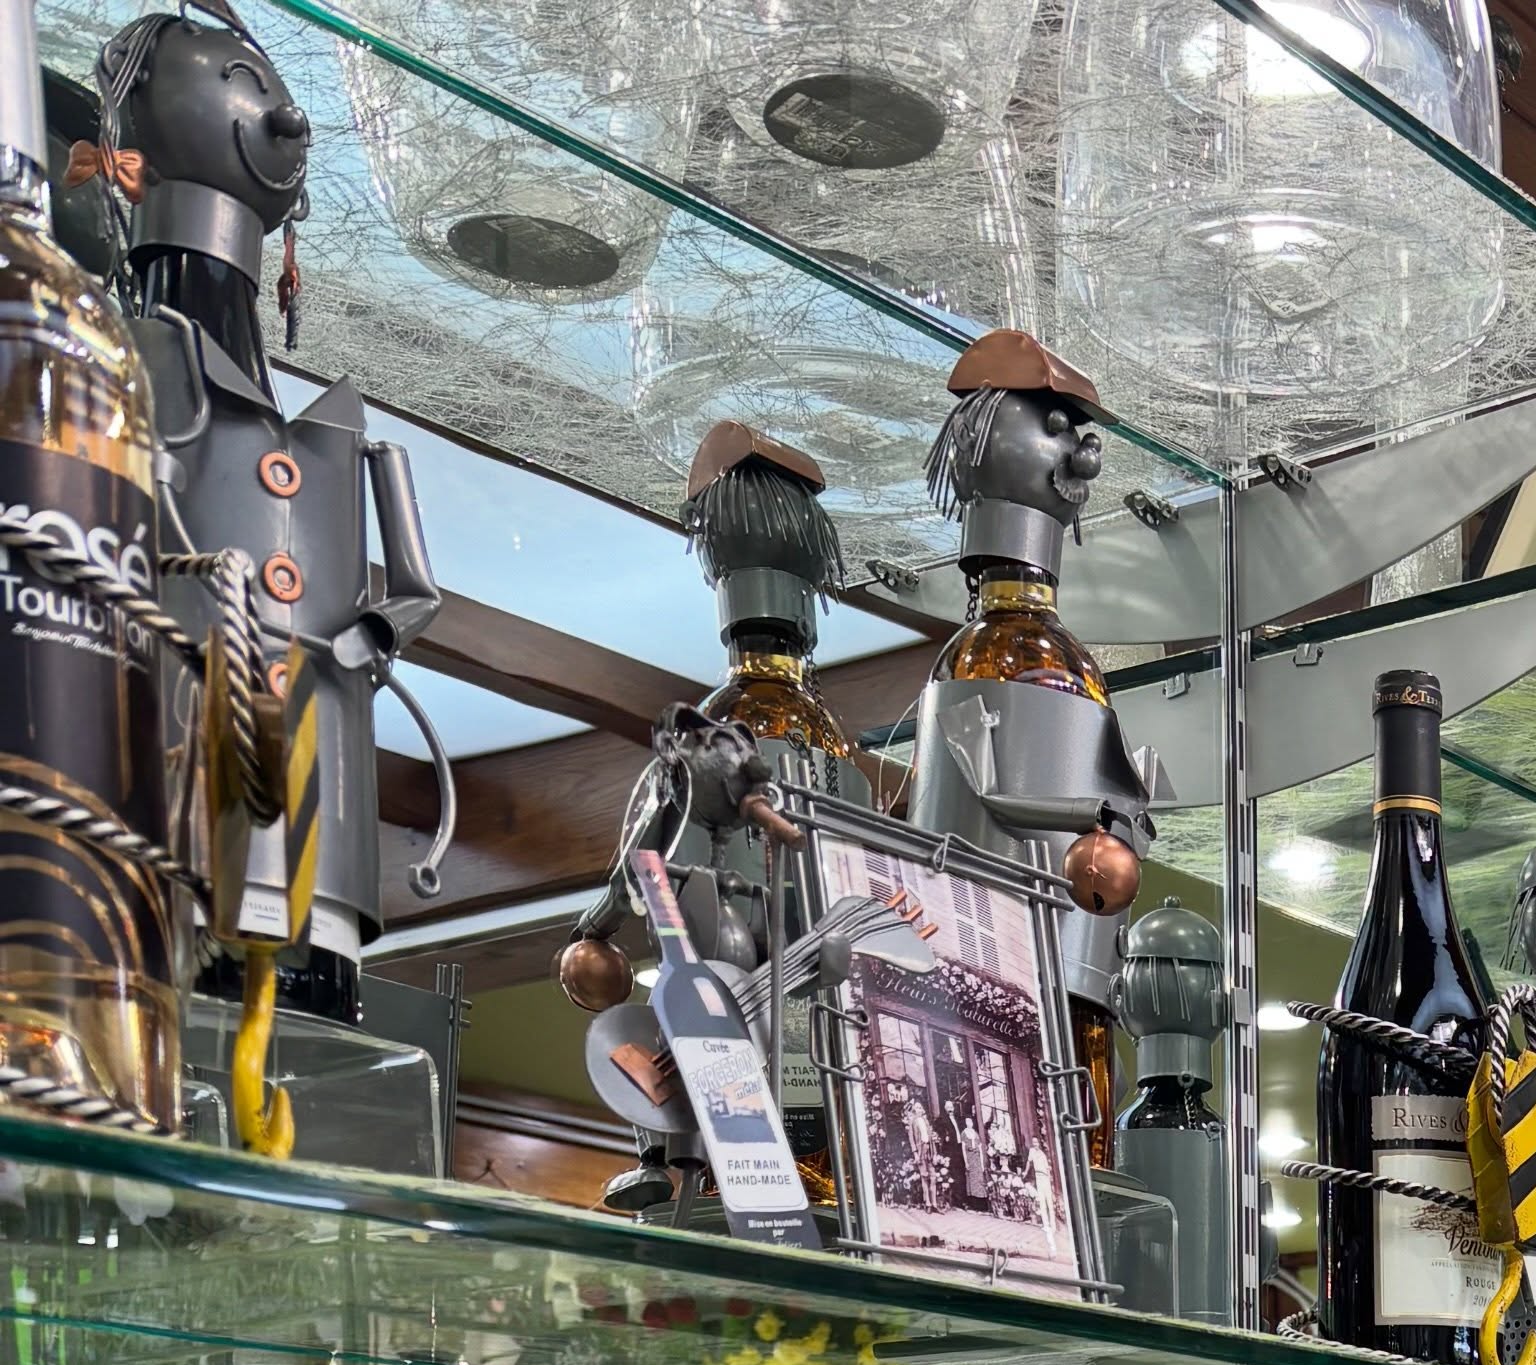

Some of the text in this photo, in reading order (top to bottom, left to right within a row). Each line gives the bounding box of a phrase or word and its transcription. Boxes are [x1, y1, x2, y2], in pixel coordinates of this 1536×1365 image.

[1392, 1107, 1447, 1130] RIVES
[727, 1158, 781, 1170] FAIT MAIN
[726, 1176, 792, 1186] HAND-MADE
[1466, 1275, 1497, 1291] ROUGE
